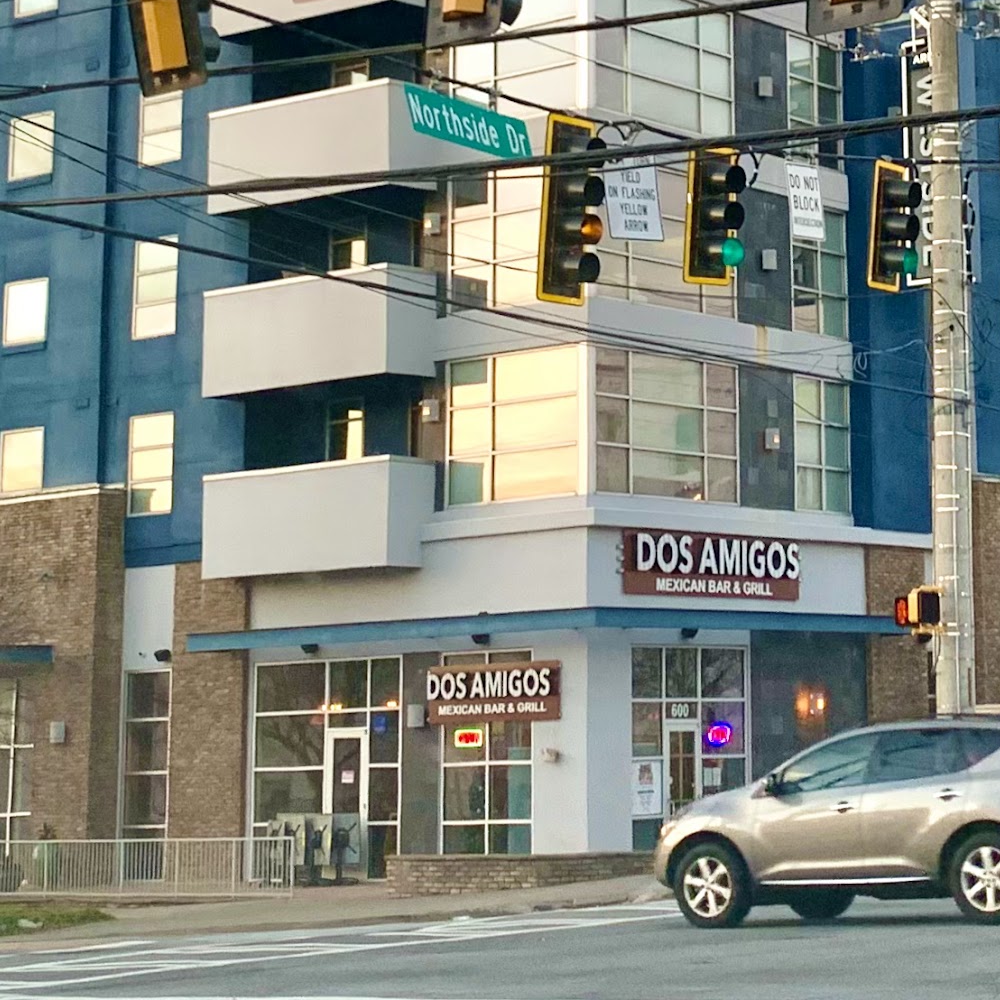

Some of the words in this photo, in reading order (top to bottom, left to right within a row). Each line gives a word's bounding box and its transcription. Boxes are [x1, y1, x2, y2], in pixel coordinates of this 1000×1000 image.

[408, 92, 500, 149] Northside
[505, 123, 527, 157] Dr
[621, 171, 641, 184] YIELD
[789, 173, 800, 189] DO
[803, 175, 819, 192] NOT
[608, 185, 618, 197] ON
[622, 187, 656, 201] FLASHING
[620, 203, 648, 216] YELLOW
[793, 194, 820, 212] BLOCK
[624, 219, 649, 232] ARROW
[636, 532, 694, 575] DOS
[699, 536, 800, 580] AMIGOS
[656, 577, 706, 593] MEXICAN
[708, 580, 731, 594] BAR
[733, 581, 741, 595] &
[743, 581, 773, 597] GRILL
[426, 671, 467, 701] DOS
[469, 667, 551, 698] AMIGOS
[438, 704, 482, 716] MEXICAN
[484, 702, 505, 714] BAR
[507, 702, 515, 713] &
[517, 701, 547, 713] GRILL
[671, 703, 689, 717] 600
